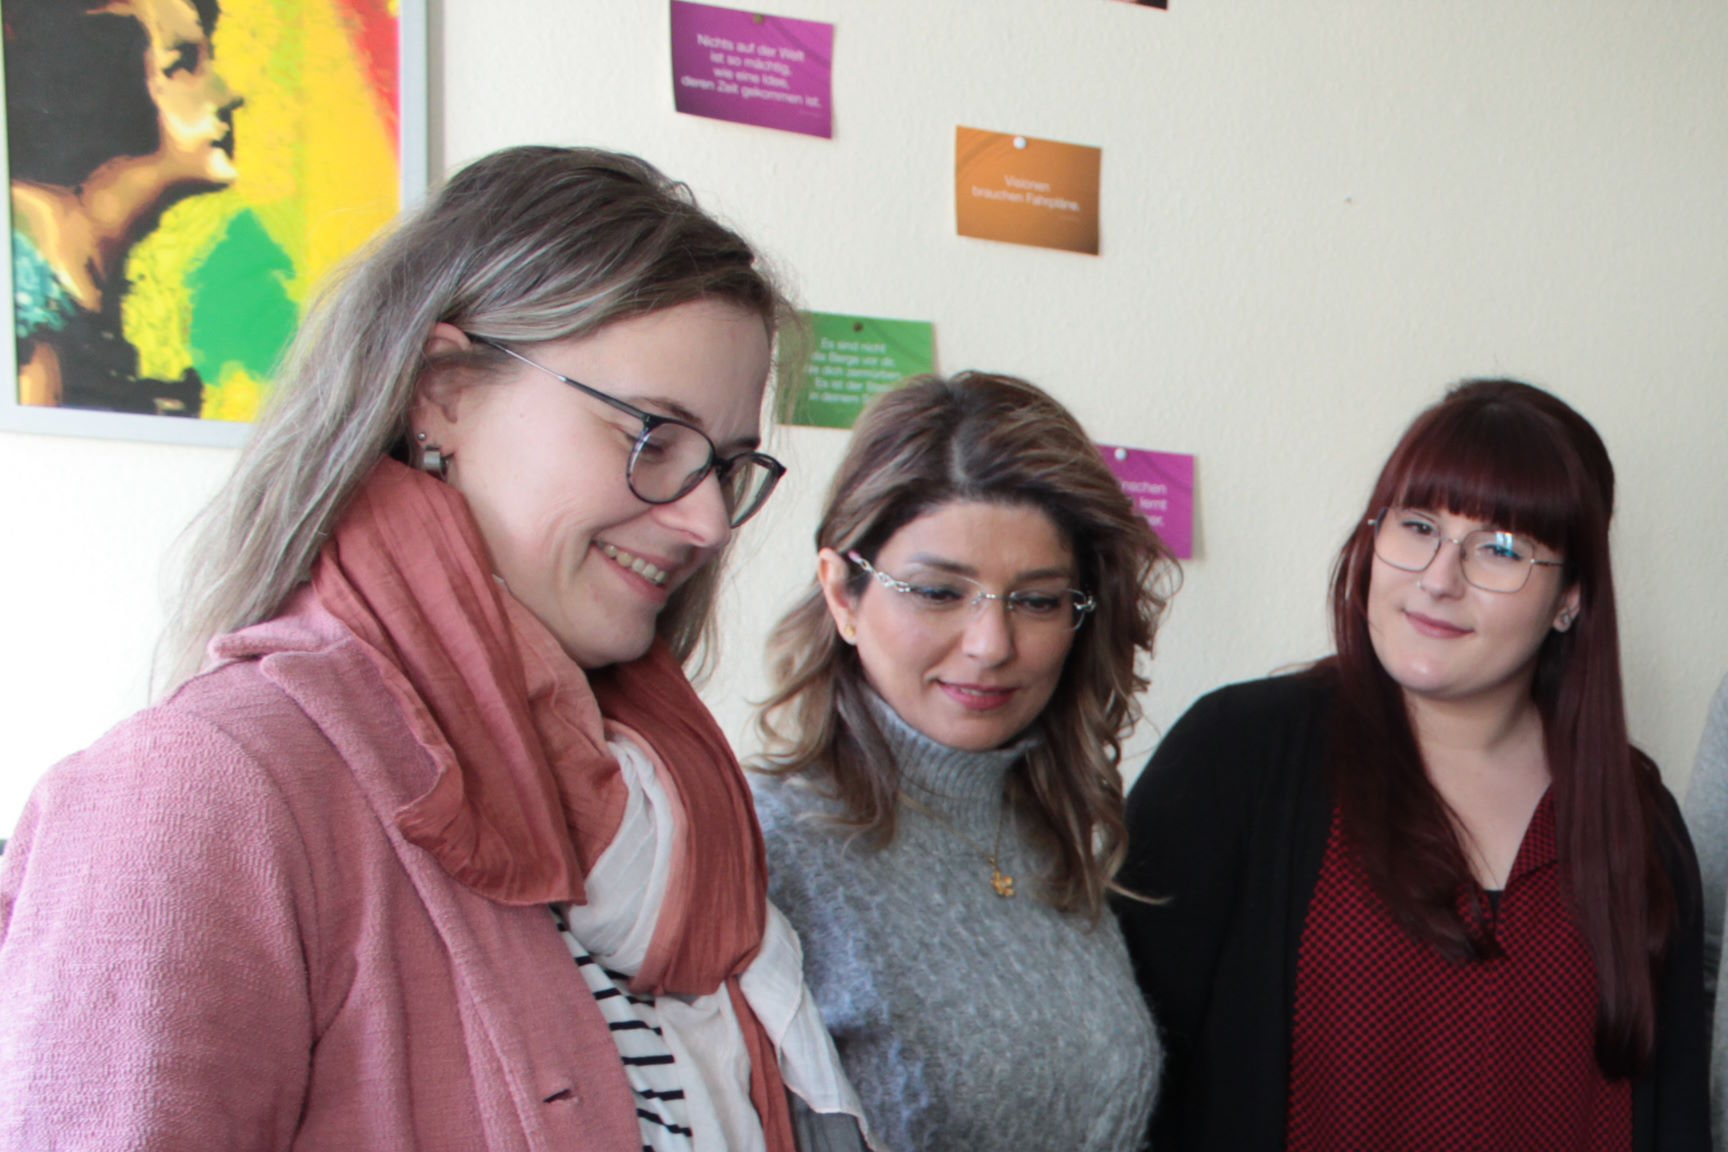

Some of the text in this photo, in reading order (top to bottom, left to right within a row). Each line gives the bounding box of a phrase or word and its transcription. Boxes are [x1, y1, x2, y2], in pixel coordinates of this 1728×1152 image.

[697, 33, 805, 62] Nichts auf der Welt
[709, 51, 725, 64] ist
[726, 55, 742, 66] so
[713, 67, 734, 80] wie
[735, 71, 760, 83] eine
[680, 75, 715, 90] deren
[717, 80, 739, 94] Zeit
[741, 85, 803, 105] gekommen
[1004, 174, 1051, 193] Visionen
[971, 184, 1024, 202] brauchen
